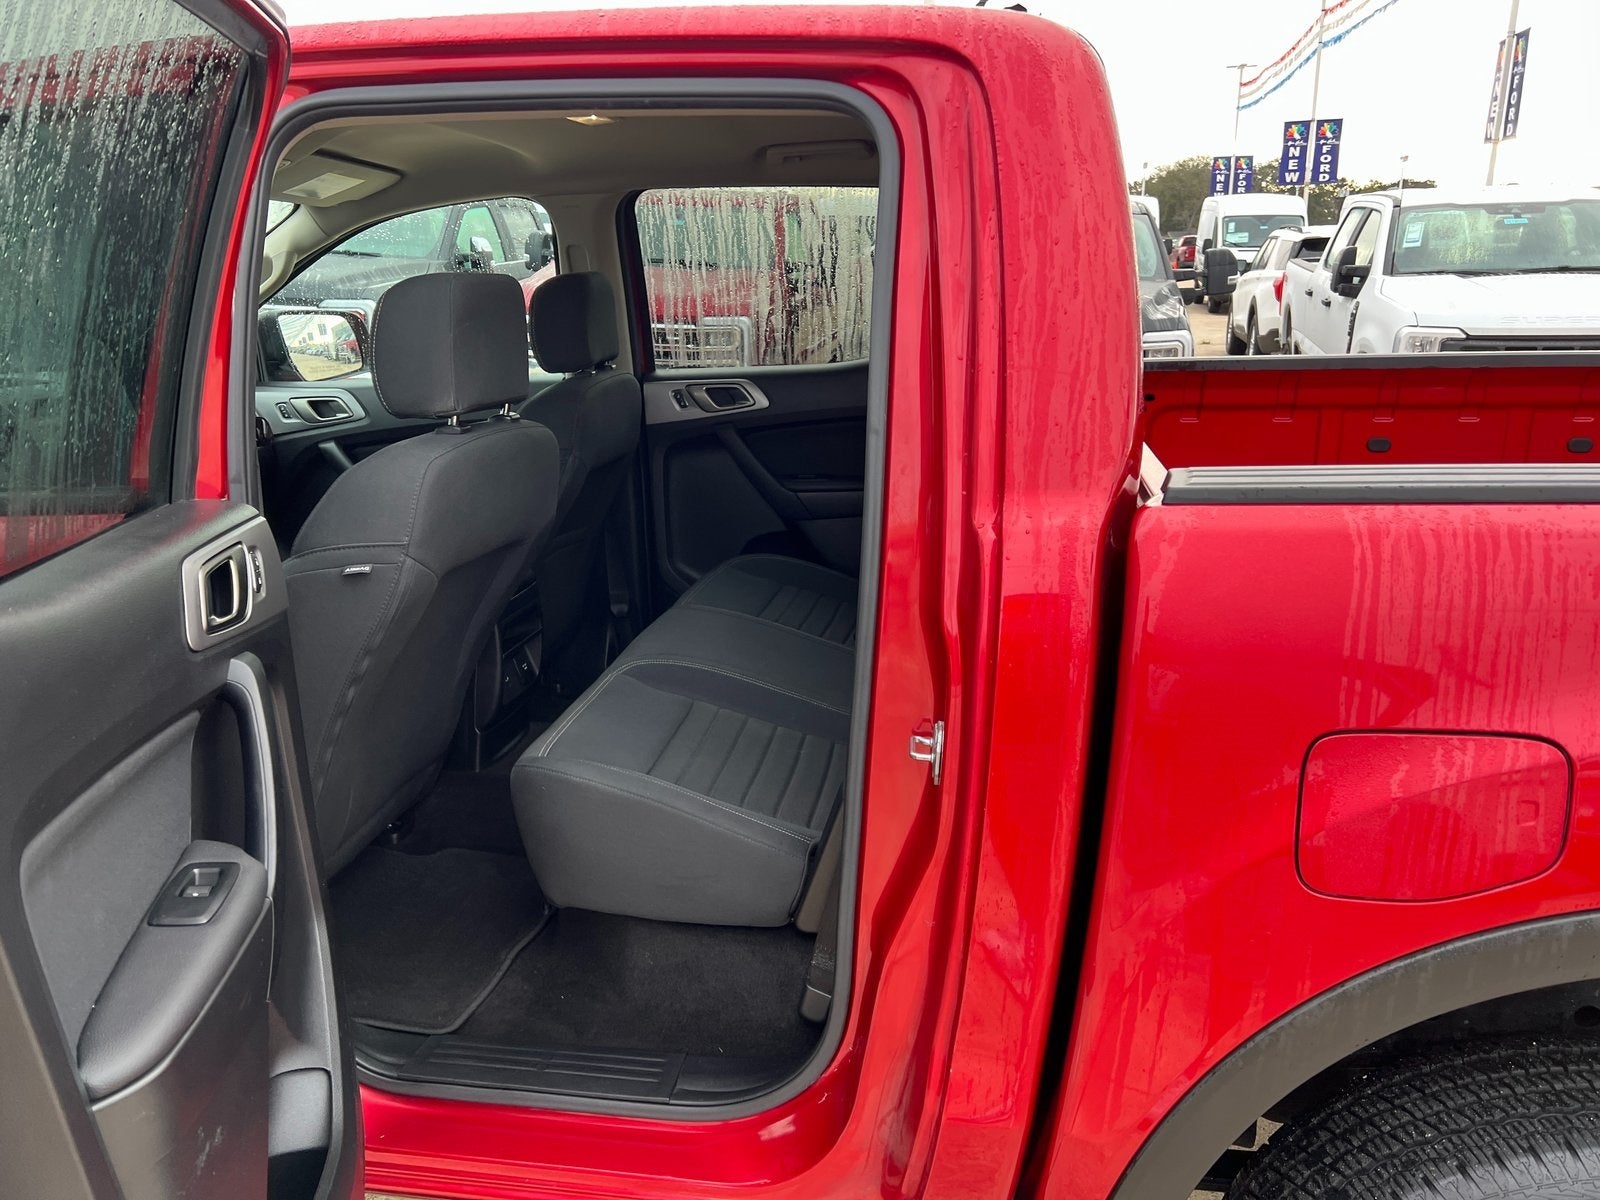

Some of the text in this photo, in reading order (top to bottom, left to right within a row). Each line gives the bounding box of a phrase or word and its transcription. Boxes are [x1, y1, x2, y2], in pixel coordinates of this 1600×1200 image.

[1506, 75, 1520, 136] FORD
[1284, 147, 1300, 182] NEW
[1319, 145, 1332, 181] FORD
[1237, 174, 1247, 193] FOR
